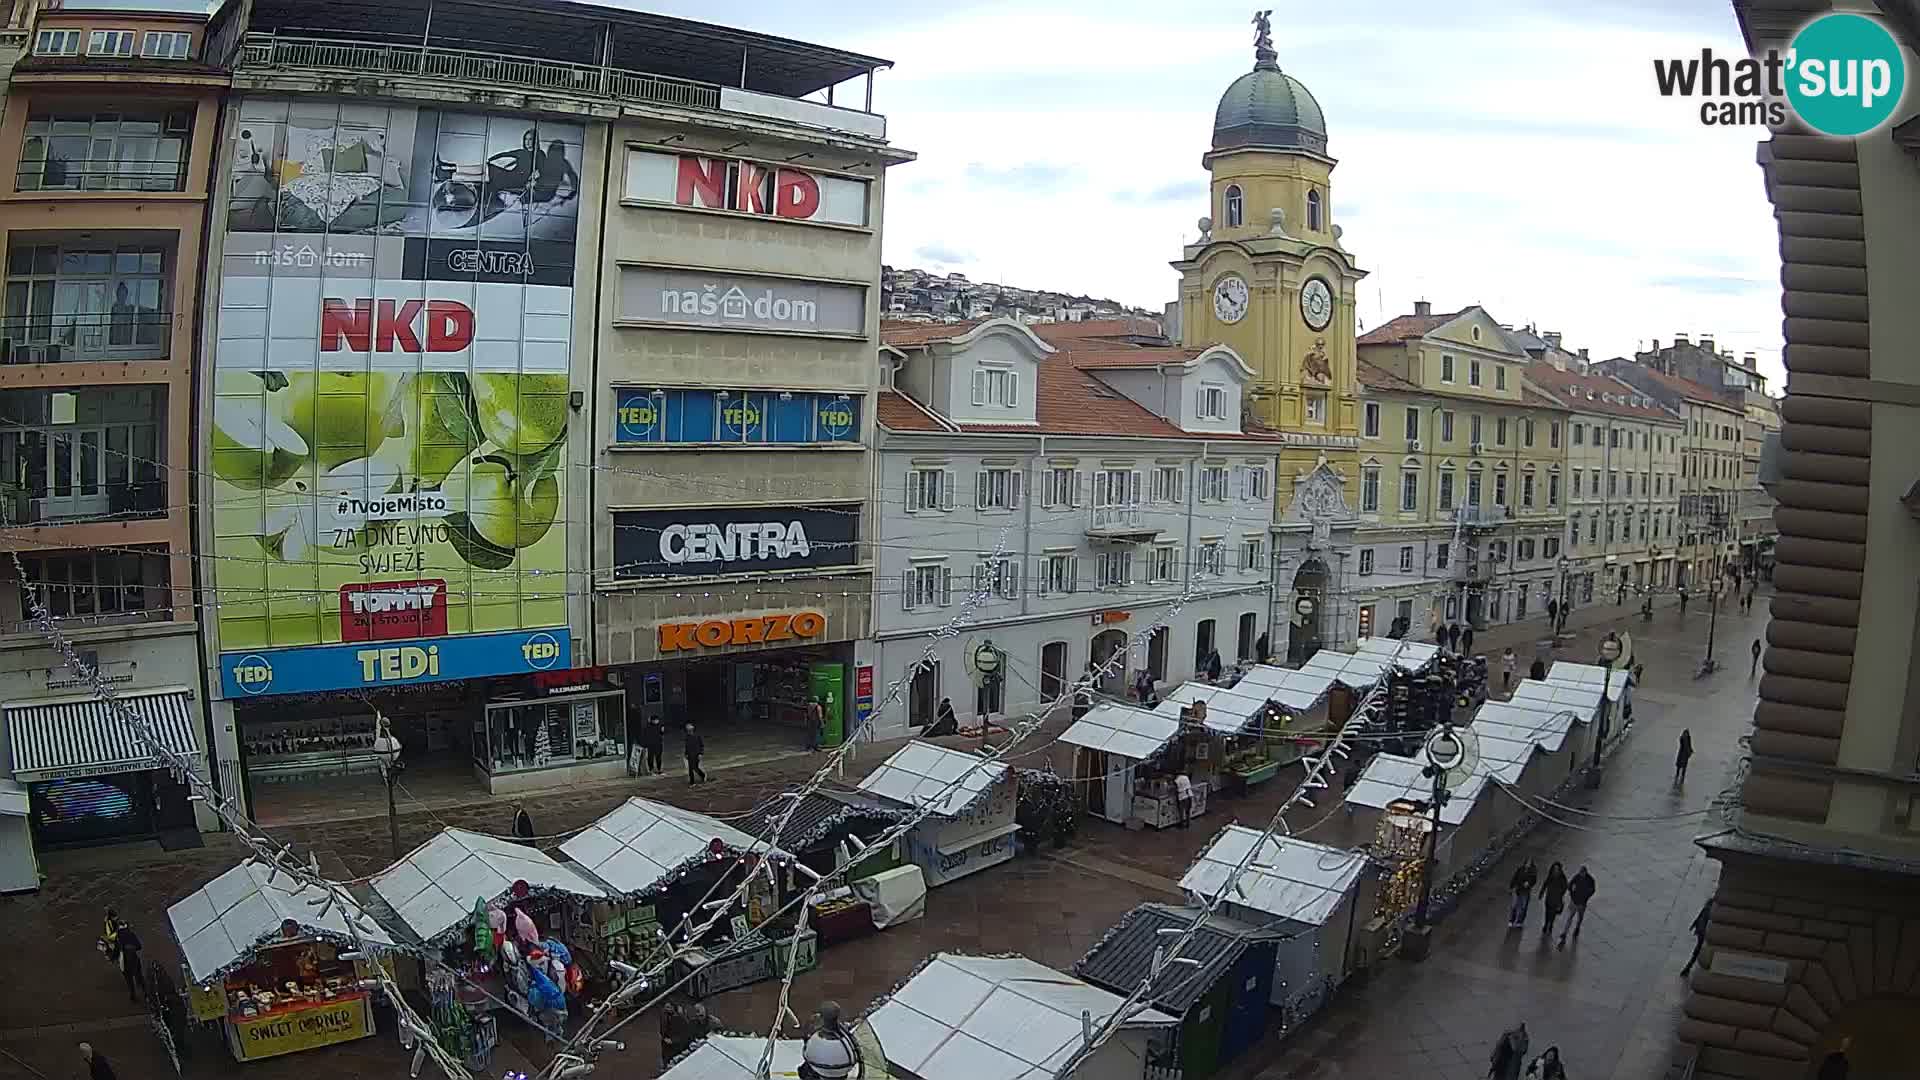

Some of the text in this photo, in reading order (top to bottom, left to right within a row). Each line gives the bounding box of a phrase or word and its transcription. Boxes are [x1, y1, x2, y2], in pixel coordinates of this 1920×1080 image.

[676, 153, 820, 219] NKD
[448, 249, 534, 275] CENTRA
[661, 283, 816, 323] naš dom
[321, 298, 476, 353] NKD
[618, 407, 657, 424] TEDi
[723, 409, 760, 425] TEDi
[819, 410, 853, 426] TEDi
[337, 498, 446, 516] #TvojeMisto
[333, 523, 450, 549] ZA DNEVNO
[659, 520, 811, 563] CENTRA
[359, 547, 426, 574] SVJEŽE
[348, 584, 439, 614] TOMMY
[659, 612, 825, 652] KORZO
[357, 645, 440, 682] TEDi
[521, 642, 560, 660] TEDi
[233, 664, 273, 684] TEDi
[250, 1021, 293, 1042] SWEET
